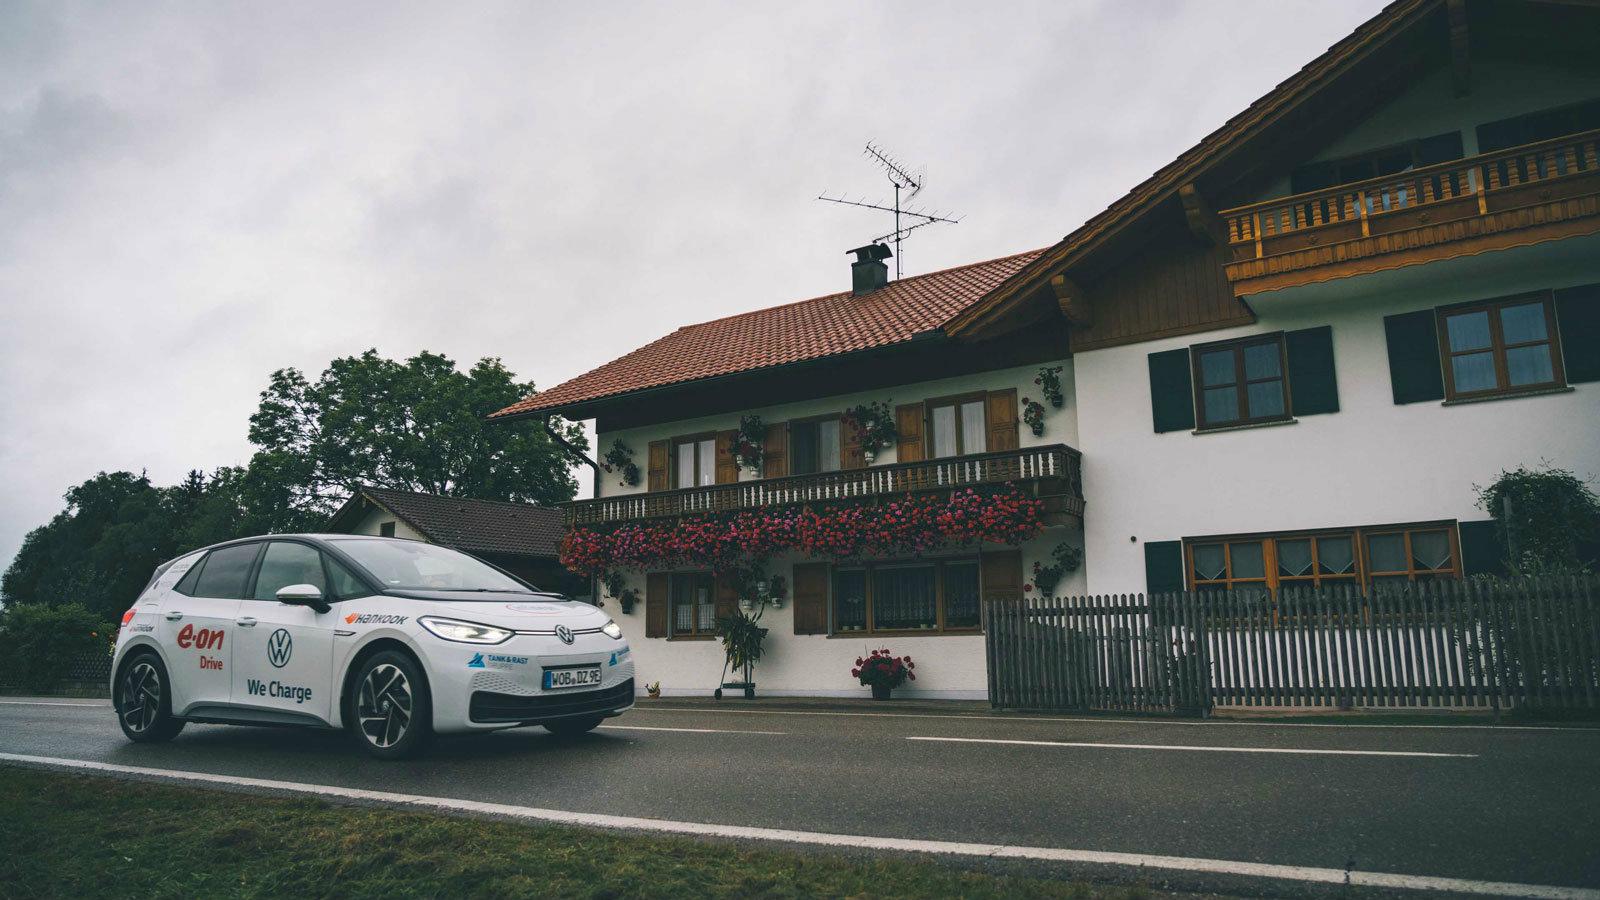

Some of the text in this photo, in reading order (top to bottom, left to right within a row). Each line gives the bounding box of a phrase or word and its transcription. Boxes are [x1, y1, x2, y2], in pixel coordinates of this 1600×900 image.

[200, 655, 224, 671] Drive
[552, 672, 571, 686] WOB
[247, 679, 312, 704] We Charge
